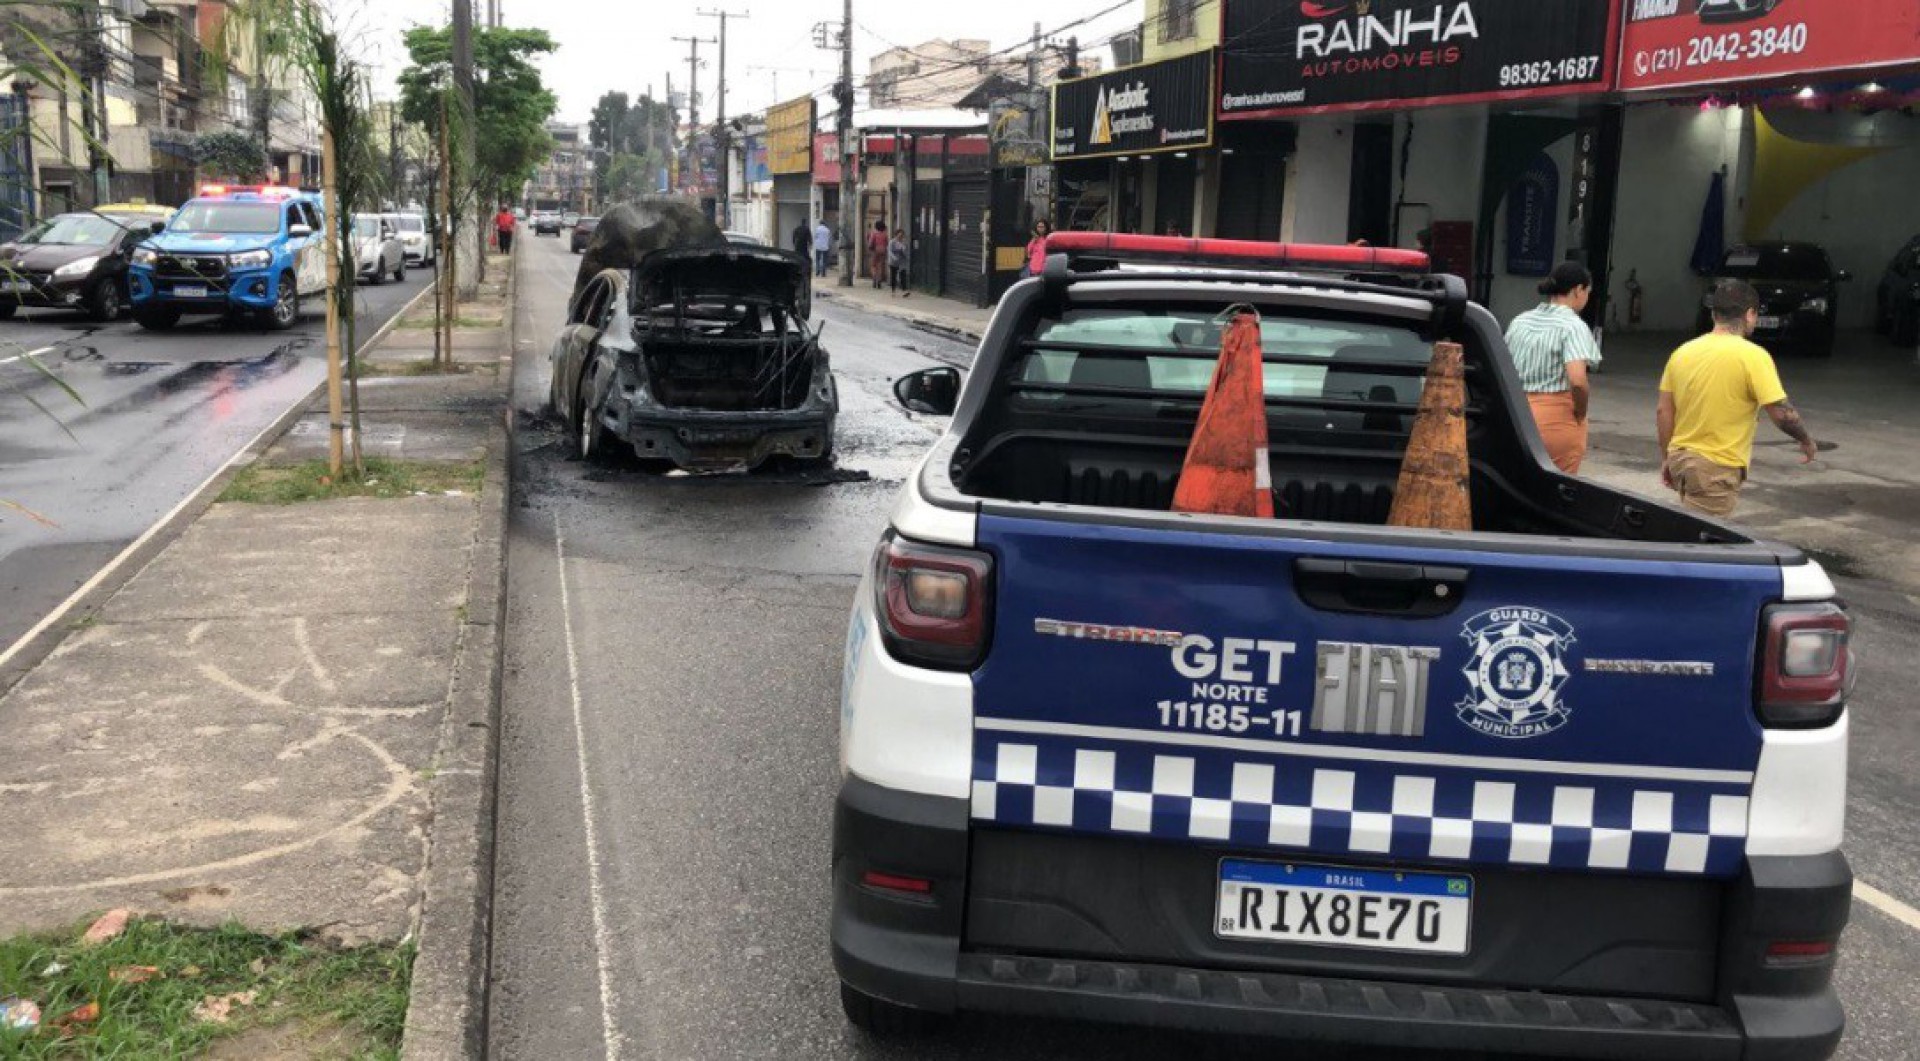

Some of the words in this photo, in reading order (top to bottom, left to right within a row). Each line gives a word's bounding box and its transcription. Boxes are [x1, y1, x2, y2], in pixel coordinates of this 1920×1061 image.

[1296, 1, 1479, 60] RAINHA
[1652, 47, 1682, 72] (21)
[1686, 22, 1808, 66] 2042-3840
[1500, 57, 1599, 86] 98362-1687
[1489, 610, 1549, 625] GUARDA
[1171, 635, 1296, 684] GET
[1192, 682, 1268, 704] NORTE
[1310, 640, 1441, 737] FIAT
[1157, 700, 1300, 736] 11185-11
[1470, 717, 1551, 736] MUNICIPAL
[1325, 873, 1365, 887] BRASIL
